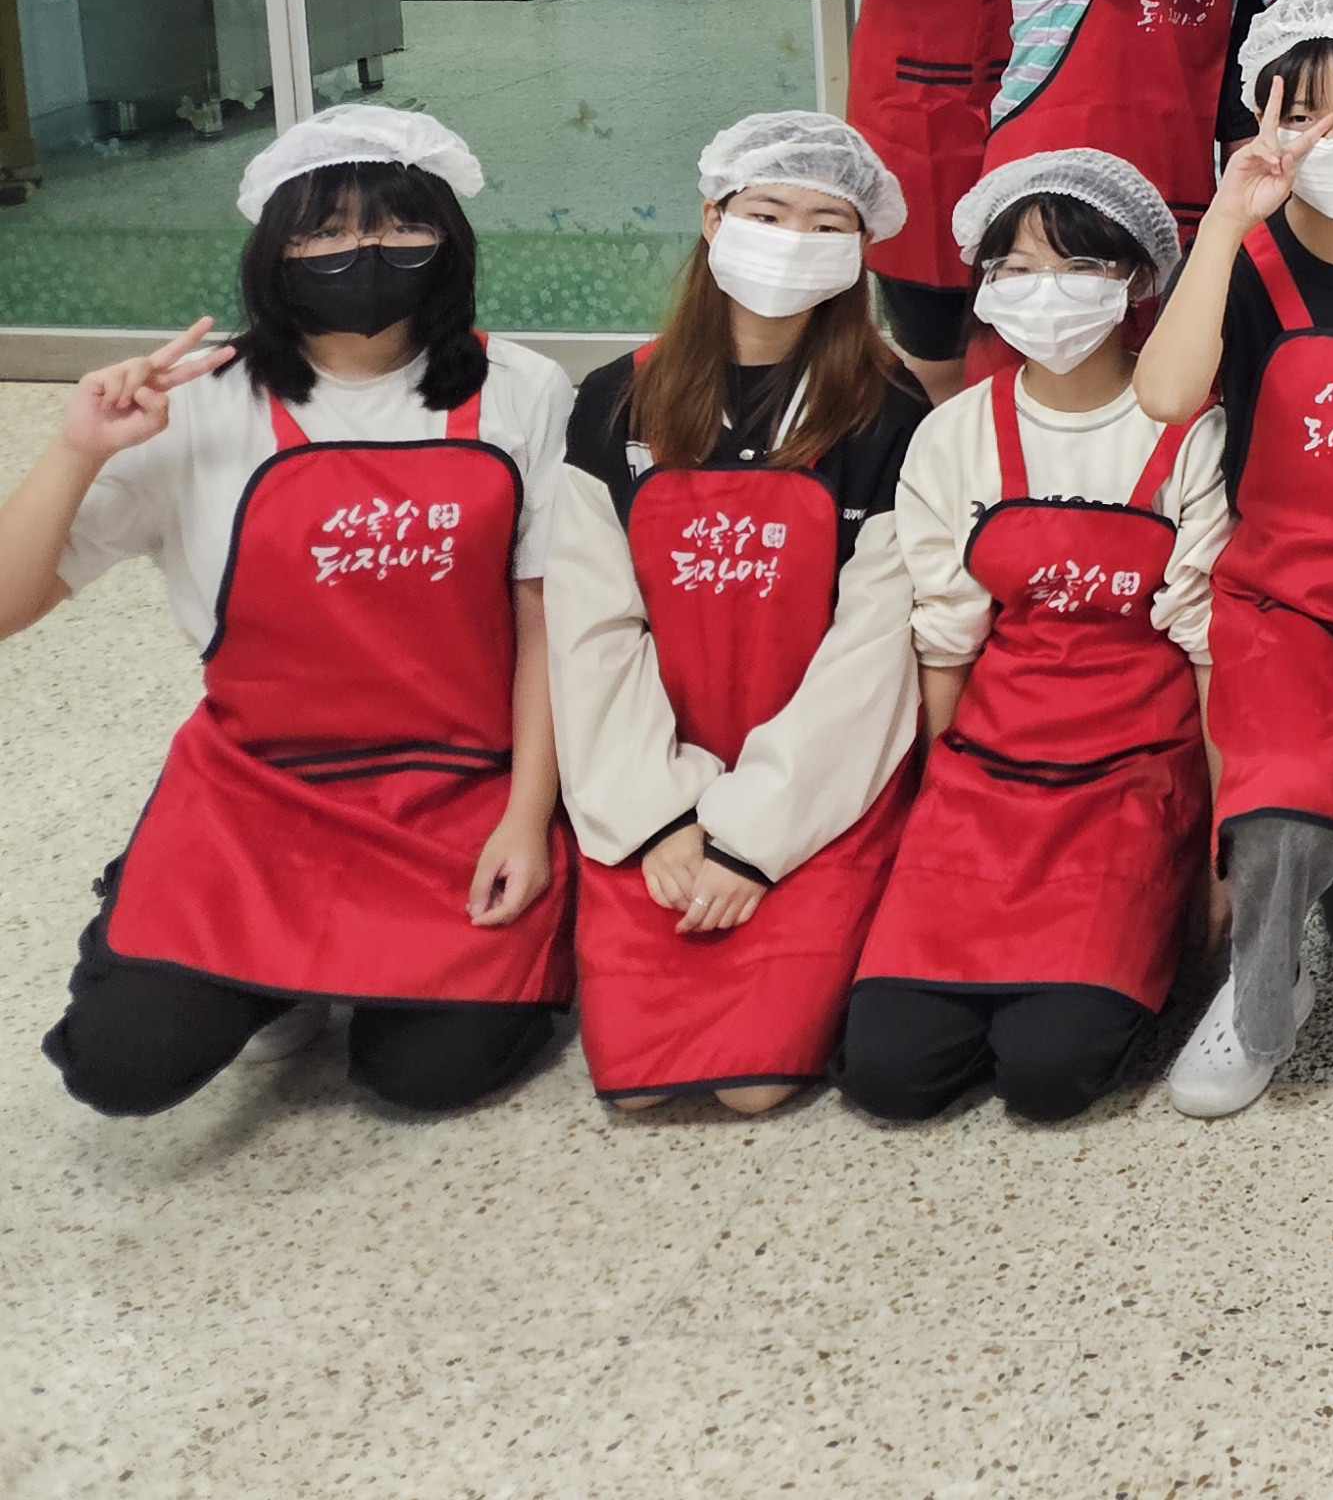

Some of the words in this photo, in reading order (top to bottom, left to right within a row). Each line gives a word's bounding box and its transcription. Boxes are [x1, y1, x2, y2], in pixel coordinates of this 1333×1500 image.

[322, 498, 419, 542] 상록수
[682, 512, 756, 555] 상록수
[310, 537, 455, 587] 된장마을
